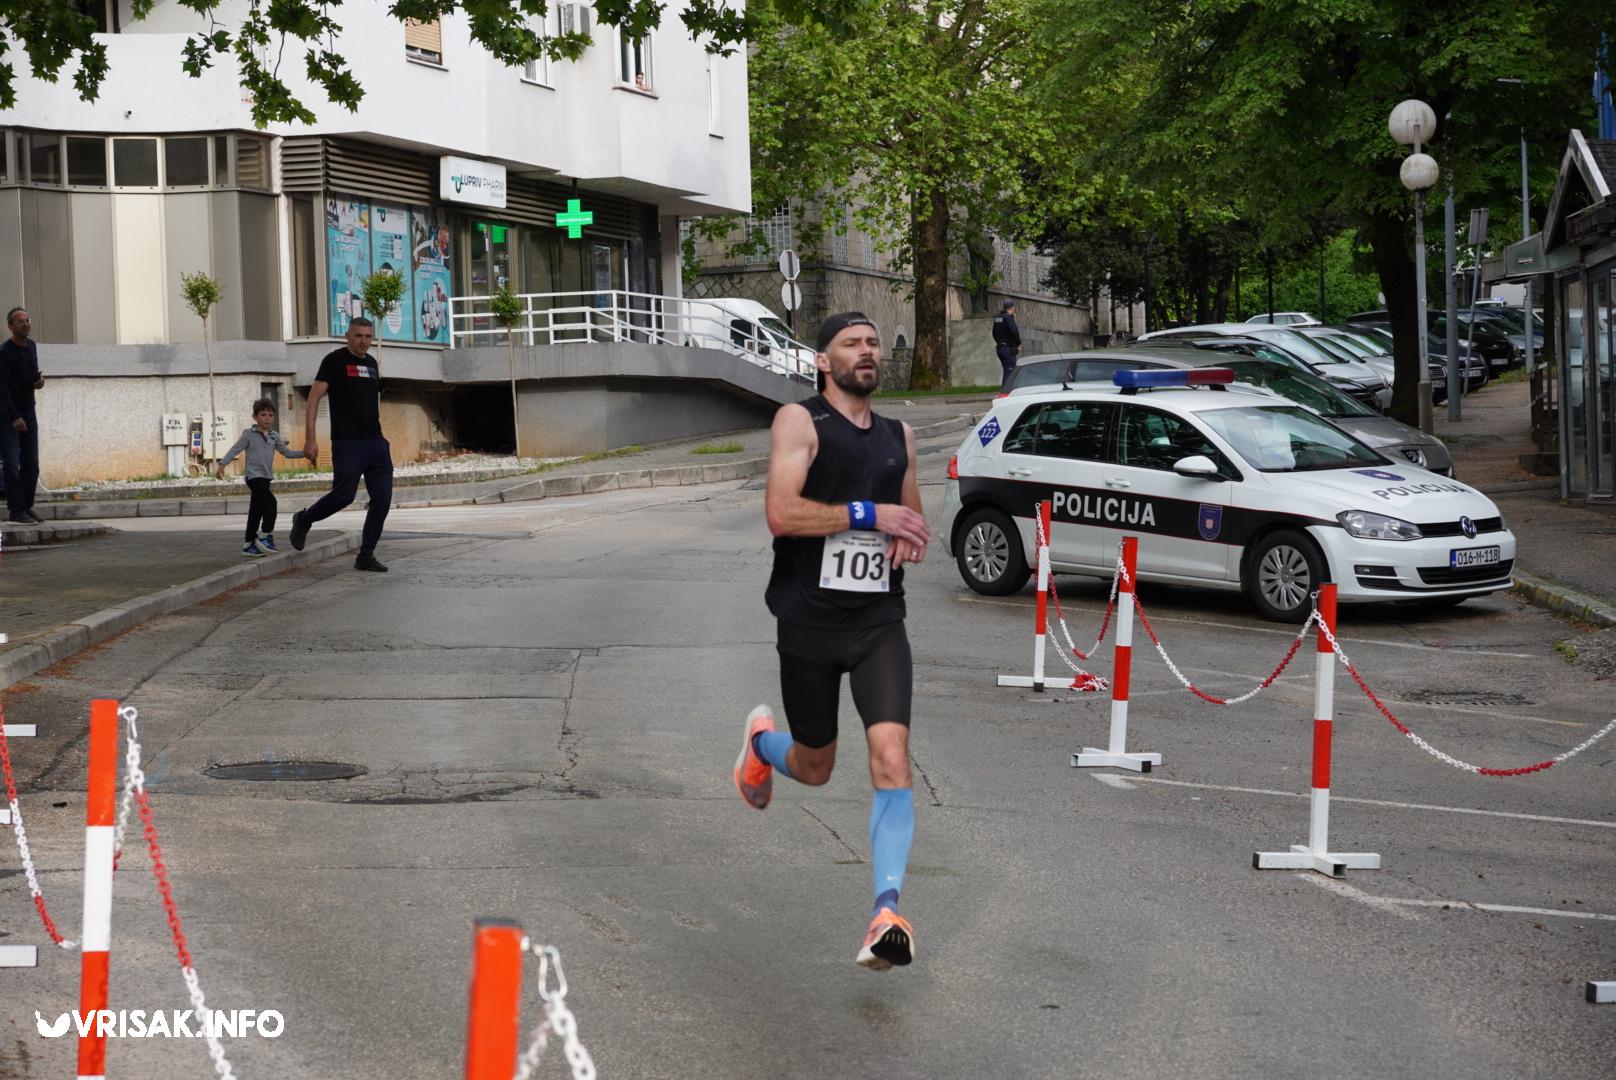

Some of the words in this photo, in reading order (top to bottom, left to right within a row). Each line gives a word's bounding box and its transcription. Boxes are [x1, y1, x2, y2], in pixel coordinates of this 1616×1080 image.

[460, 174, 482, 189] LUPRIV
[483, 177, 505, 191] PHARM
[980, 427, 997, 439] 122
[1372, 483, 1474, 501] POLICIJA
[1052, 491, 1156, 528] POLICIJA
[832, 549, 885, 581] 103
[1456, 548, 1500, 567] 016-M-118
